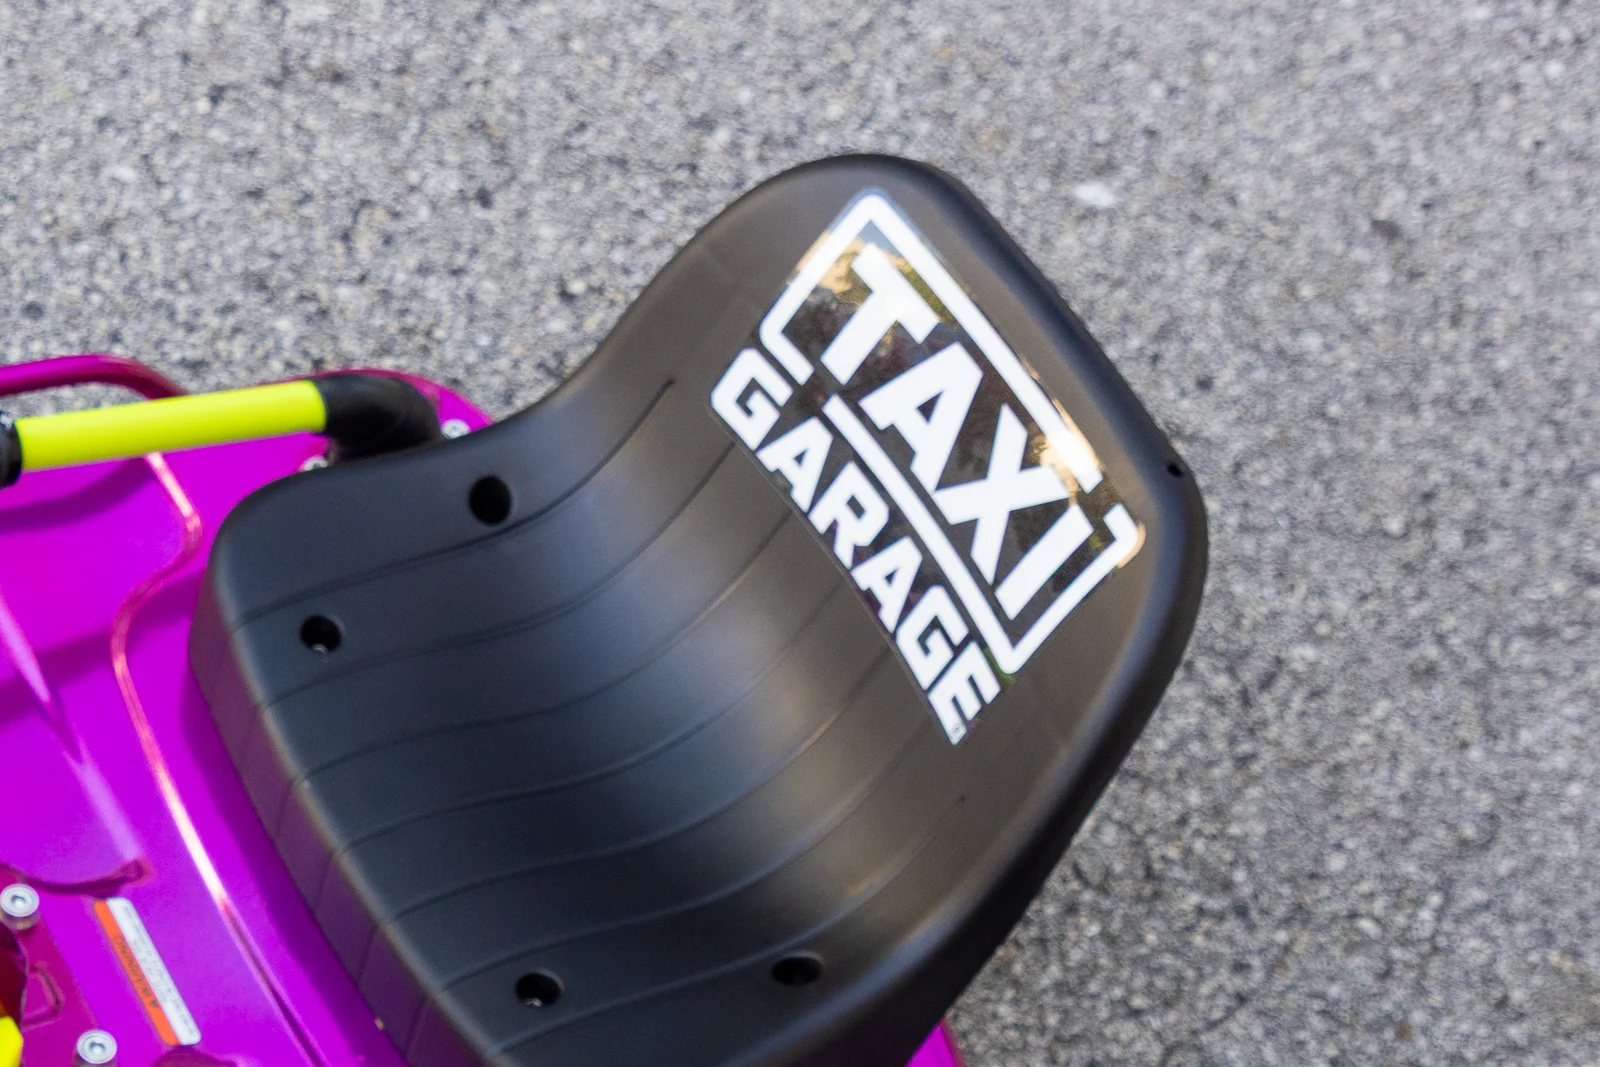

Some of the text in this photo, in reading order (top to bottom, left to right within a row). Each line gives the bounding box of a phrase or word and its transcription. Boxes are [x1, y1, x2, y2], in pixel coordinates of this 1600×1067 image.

[711, 348, 1001, 746] GARAGE
[820, 243, 1094, 620] TAXI
[112, 935, 152, 998] WARNING
